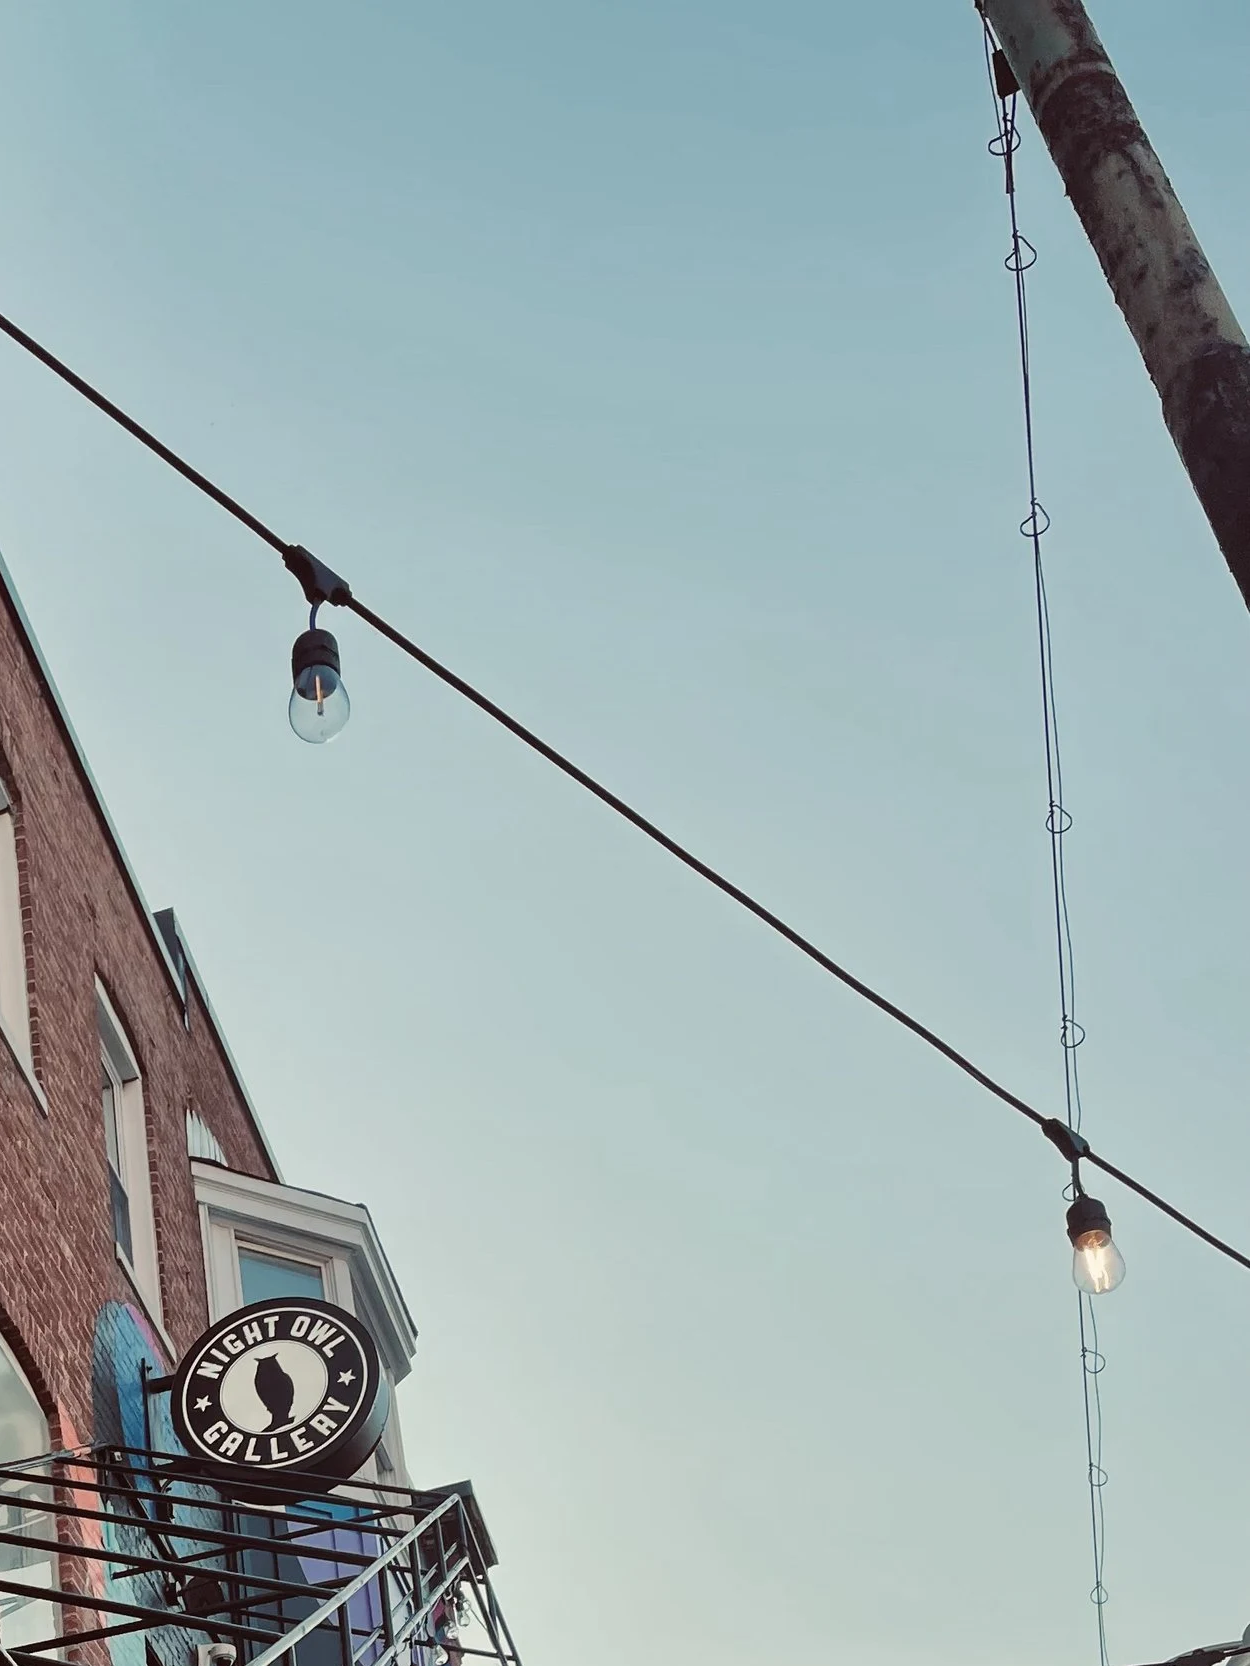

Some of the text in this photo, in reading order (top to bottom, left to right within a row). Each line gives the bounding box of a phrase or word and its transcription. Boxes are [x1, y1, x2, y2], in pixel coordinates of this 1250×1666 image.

[196, 1315, 346, 1380] NIGHT OWL
[202, 1396, 351, 1463] GALLERY
